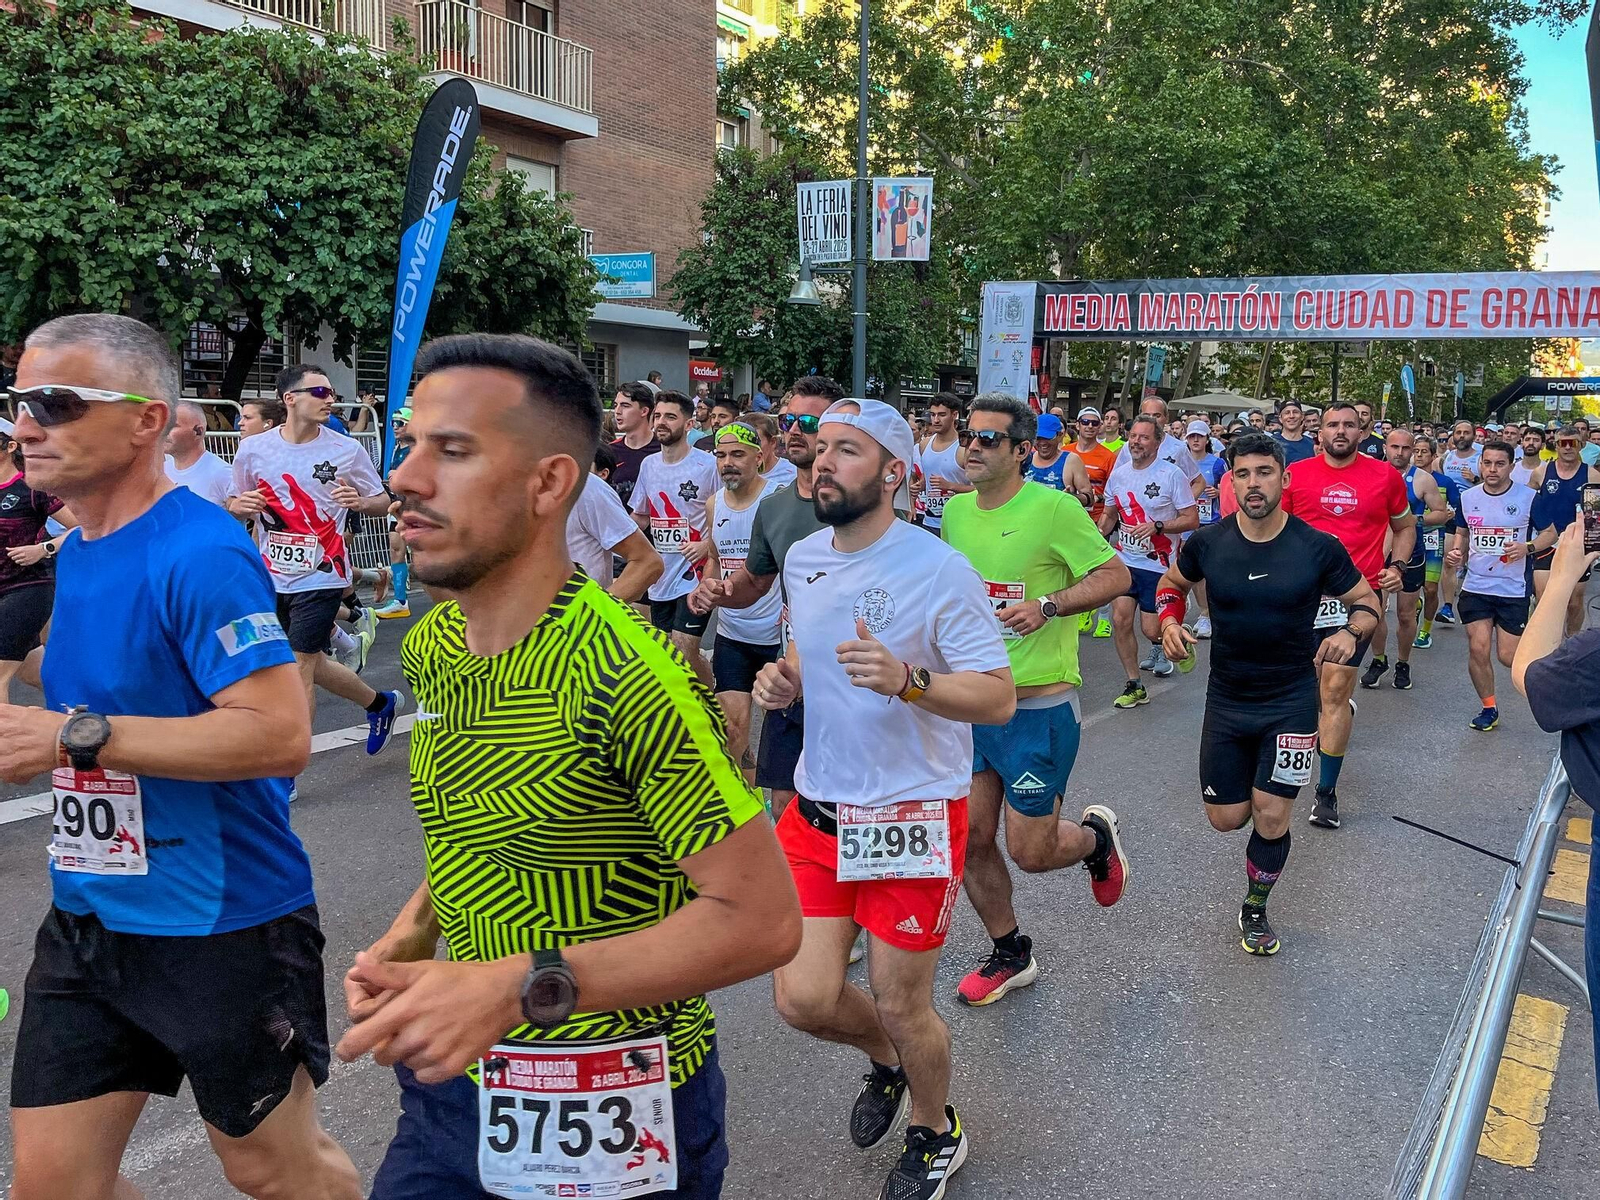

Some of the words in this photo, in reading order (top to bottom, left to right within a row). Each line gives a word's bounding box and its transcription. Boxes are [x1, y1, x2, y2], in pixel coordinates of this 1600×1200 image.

[801, 190, 812, 215] LA
[817, 187, 847, 214] FERIA
[394, 105, 471, 342] POWERADE
[802, 215, 818, 241] DEL
[822, 213, 847, 240] VINO
[834, 239, 848, 252] 2025
[1044, 293, 1131, 331] MEDIA
[1138, 284, 1282, 331] MARATÓN
[1293, 289, 1415, 330] CIUDAD
[1425, 288, 1471, 328] DE
[1480, 286, 1600, 328] GRANA
[1474, 536, 1505, 547] 1597
[270, 543, 305, 563] 3793
[1280, 736, 1291, 748] 41
[1278, 750, 1312, 770] 388
[54, 793, 116, 841] 90
[840, 806, 857, 823] 41
[840, 824, 930, 860] 5298
[895, 923, 923, 934] adidas
[534, 1058, 578, 1076] MARATÓN
[533, 1076, 544, 1089] DE
[543, 1076, 579, 1090] GRANADA
[591, 1074, 602, 1088] 26
[602, 1071, 628, 1087] ABRIL
[653, 1098, 663, 1126] SENIOR
[486, 1095, 637, 1158] 5753
